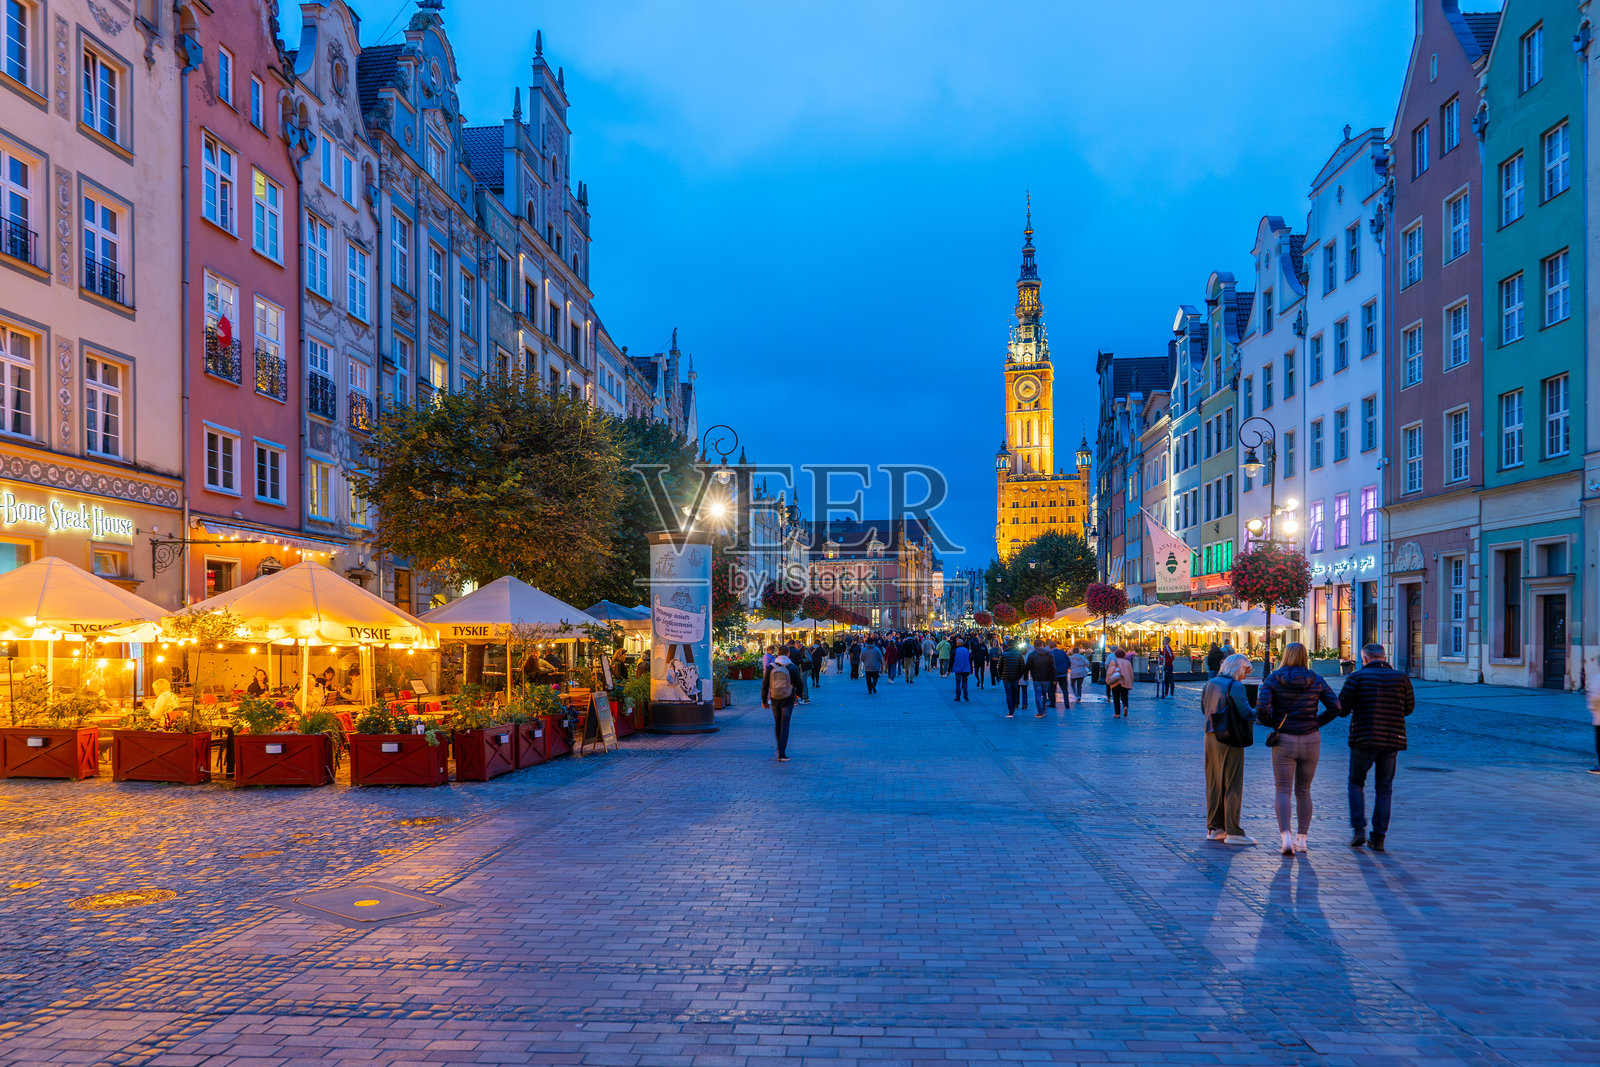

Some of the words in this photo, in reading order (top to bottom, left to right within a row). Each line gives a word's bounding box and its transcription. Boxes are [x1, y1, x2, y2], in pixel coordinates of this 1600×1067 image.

[0, 492, 47, 525] -Bone
[49, 499, 91, 531] Steak
[92, 507, 134, 538] House
[347, 626, 392, 641] TYSKIE
[451, 626, 489, 636] TYSKIE
